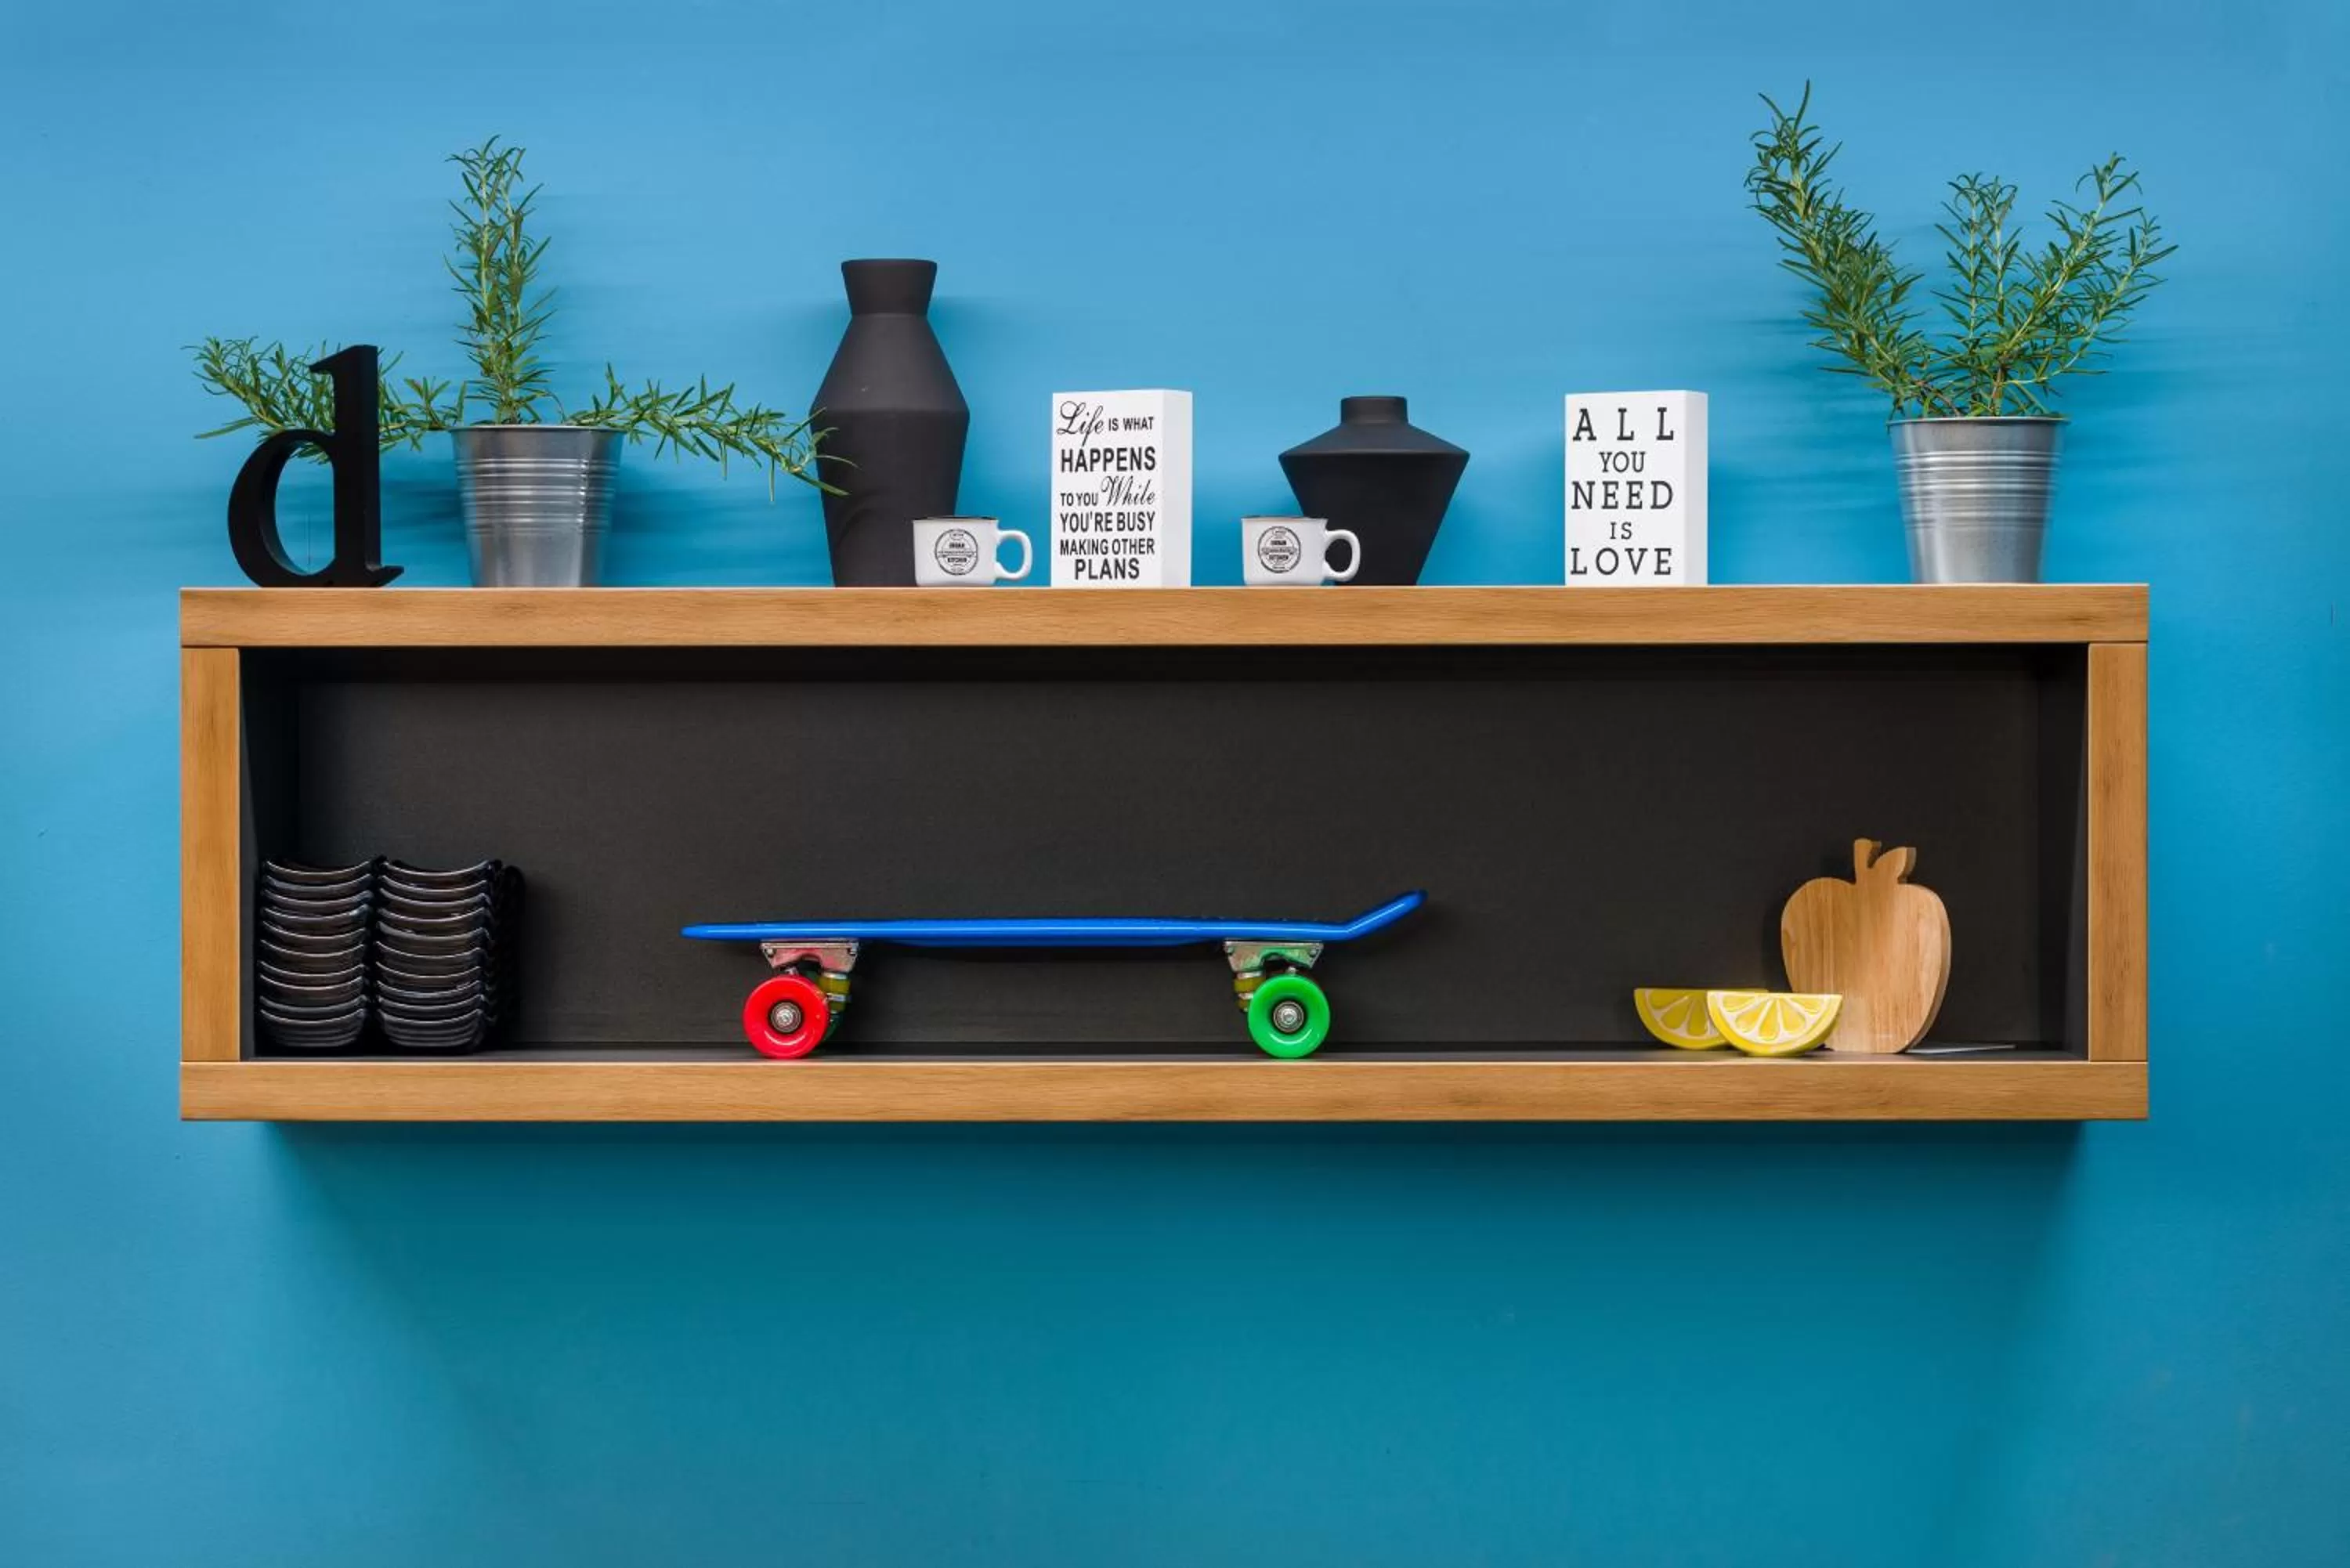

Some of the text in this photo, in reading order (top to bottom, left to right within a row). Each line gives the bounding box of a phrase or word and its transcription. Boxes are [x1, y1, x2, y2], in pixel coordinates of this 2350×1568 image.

[1057, 400, 1154, 447] Life IS WHAT
[1573, 407, 1674, 441] ALL
[1061, 446, 1155, 473] HAPPENS
[1599, 451, 1646, 473] YOU
[1060, 475, 1155, 507] TO YOU While
[1571, 481, 1673, 510] NEED
[1060, 511, 1155, 533] YOU'RE BUSY
[1610, 522, 1632, 540] IS
[1060, 538, 1155, 555] MAKING OTHER
[1075, 558, 1140, 580] PLANS
[1571, 547, 1672, 576] LOVE
